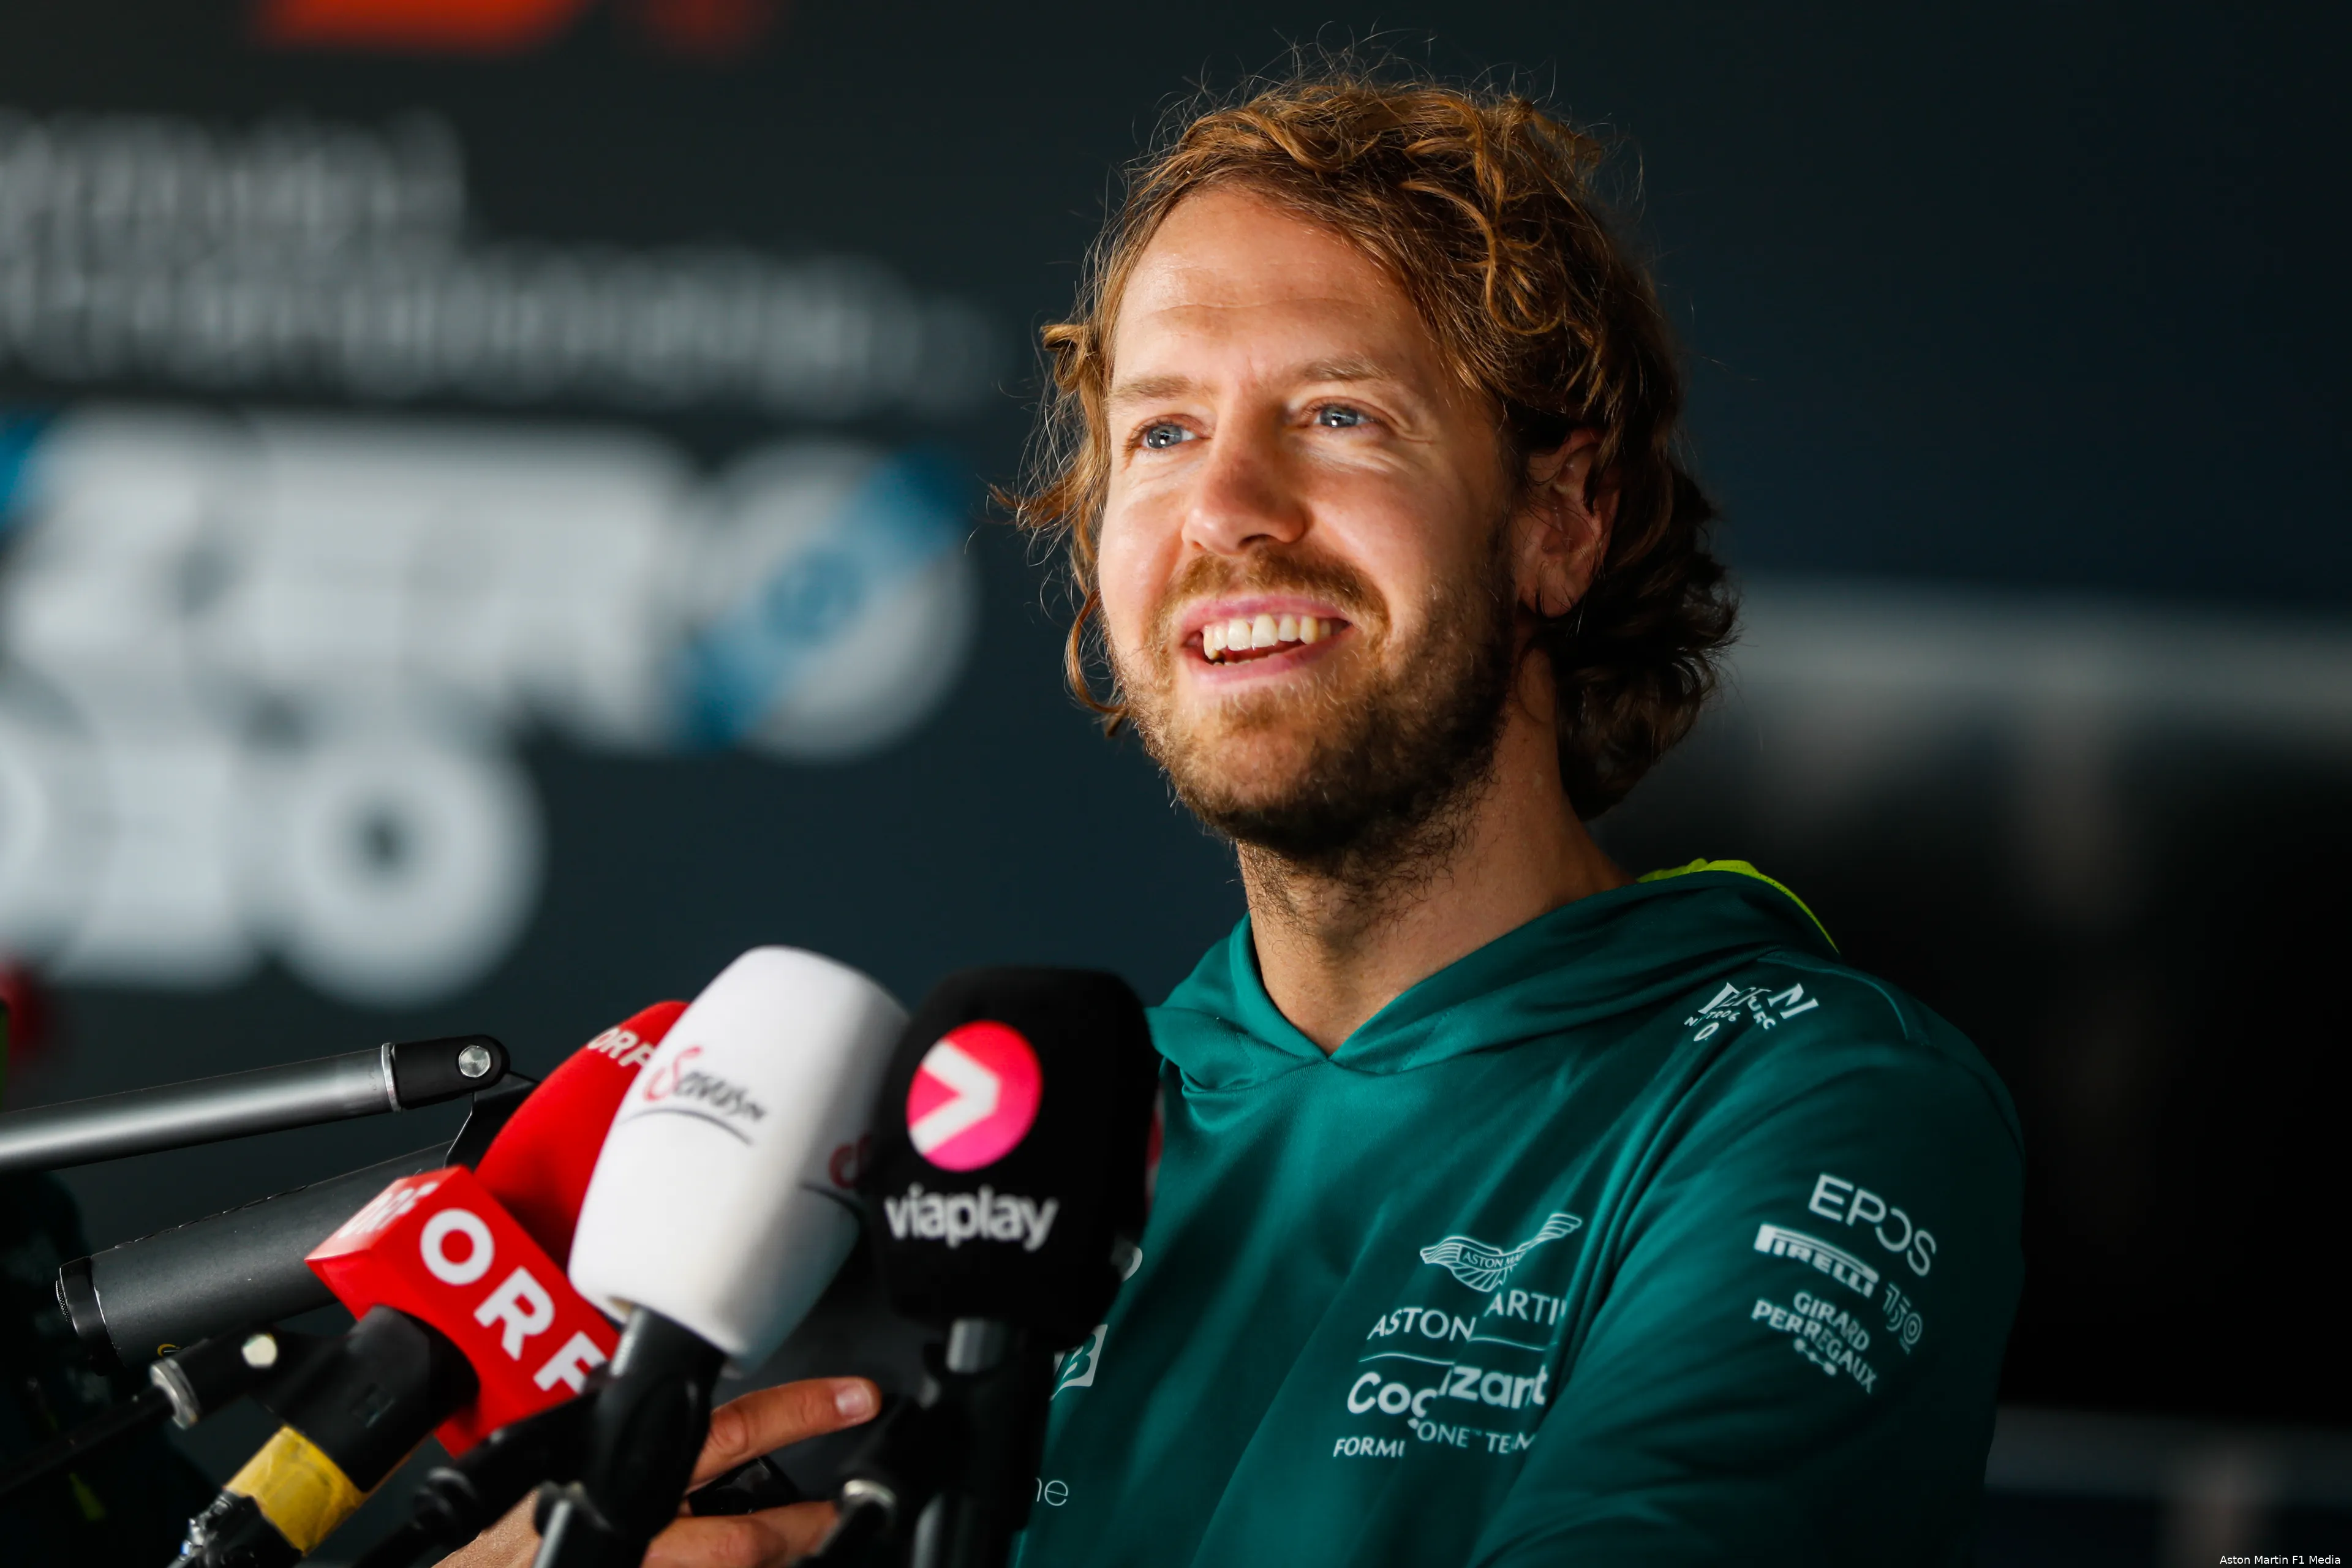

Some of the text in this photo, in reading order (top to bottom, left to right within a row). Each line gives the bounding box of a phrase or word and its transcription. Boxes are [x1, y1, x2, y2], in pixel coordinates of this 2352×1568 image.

[883, 1183, 1058, 1251] viaplay
[1808, 1172, 1937, 1276] EPOS
[1753, 1221, 1880, 1298] PIRELLI
[420, 1207, 608, 1394] ORF
[1366, 1307, 1477, 1341] ASTON
[1793, 1291, 1871, 1352] GIRARD
[1751, 1298, 1878, 1395] PERREGAUX
